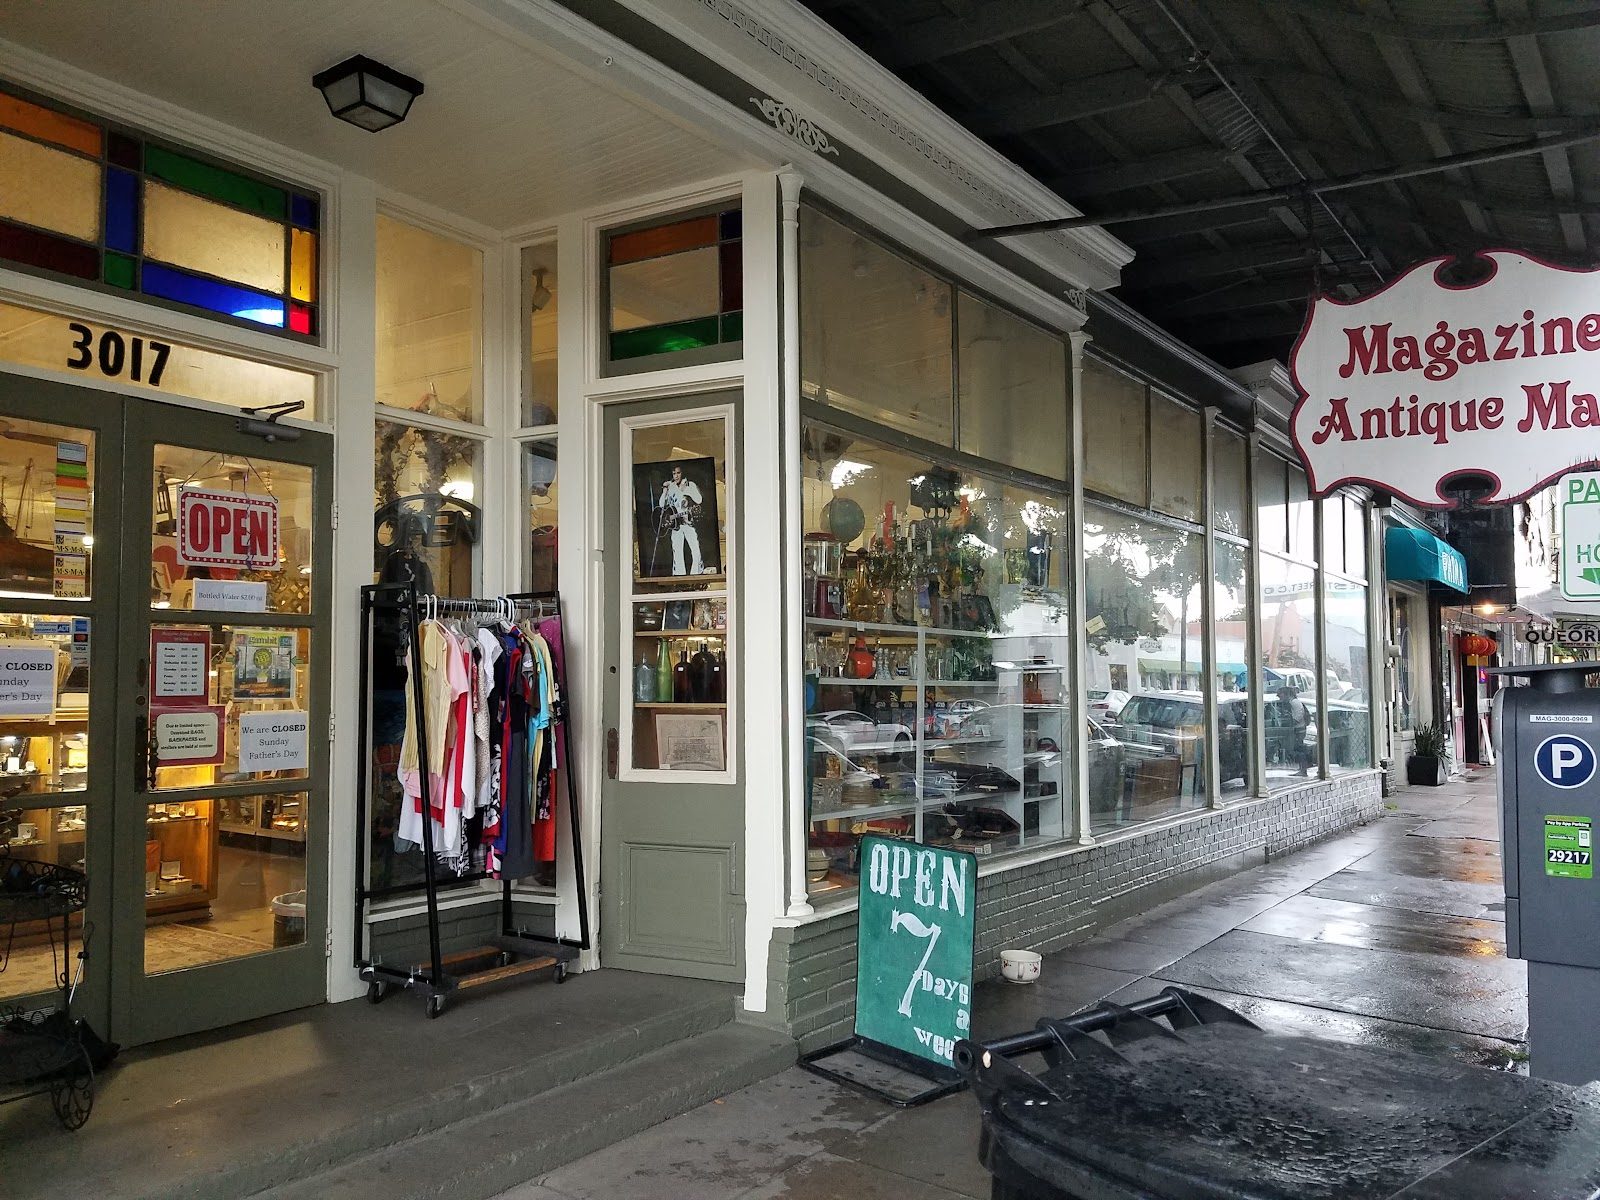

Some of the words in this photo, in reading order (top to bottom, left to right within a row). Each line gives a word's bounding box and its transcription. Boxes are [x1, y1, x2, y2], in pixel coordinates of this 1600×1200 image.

[67, 322, 171, 386] 3017
[1338, 309, 1600, 381] Magazine
[1311, 394, 1504, 445] Antique
[189, 503, 269, 557] OPEN
[198, 592, 221, 600] Bottled
[1525, 630, 1600, 644] QUEOR
[6, 662, 53, 671] CLOSED
[22, 692, 42, 702] Day
[242, 726, 254, 734] We
[271, 724, 307, 733] CLOSED
[259, 738, 290, 747] Sunday
[249, 750, 282, 760] Father's
[283, 749, 299, 759] Day
[1552, 743, 1583, 779] P
[1549, 850, 1590, 864] 29217
[869, 843, 968, 918] OPEN
[889, 906, 942, 1019] 7
[922, 969, 970, 1005] Days
[956, 1009, 970, 1031] a
[913, 1026, 963, 1061] wee
